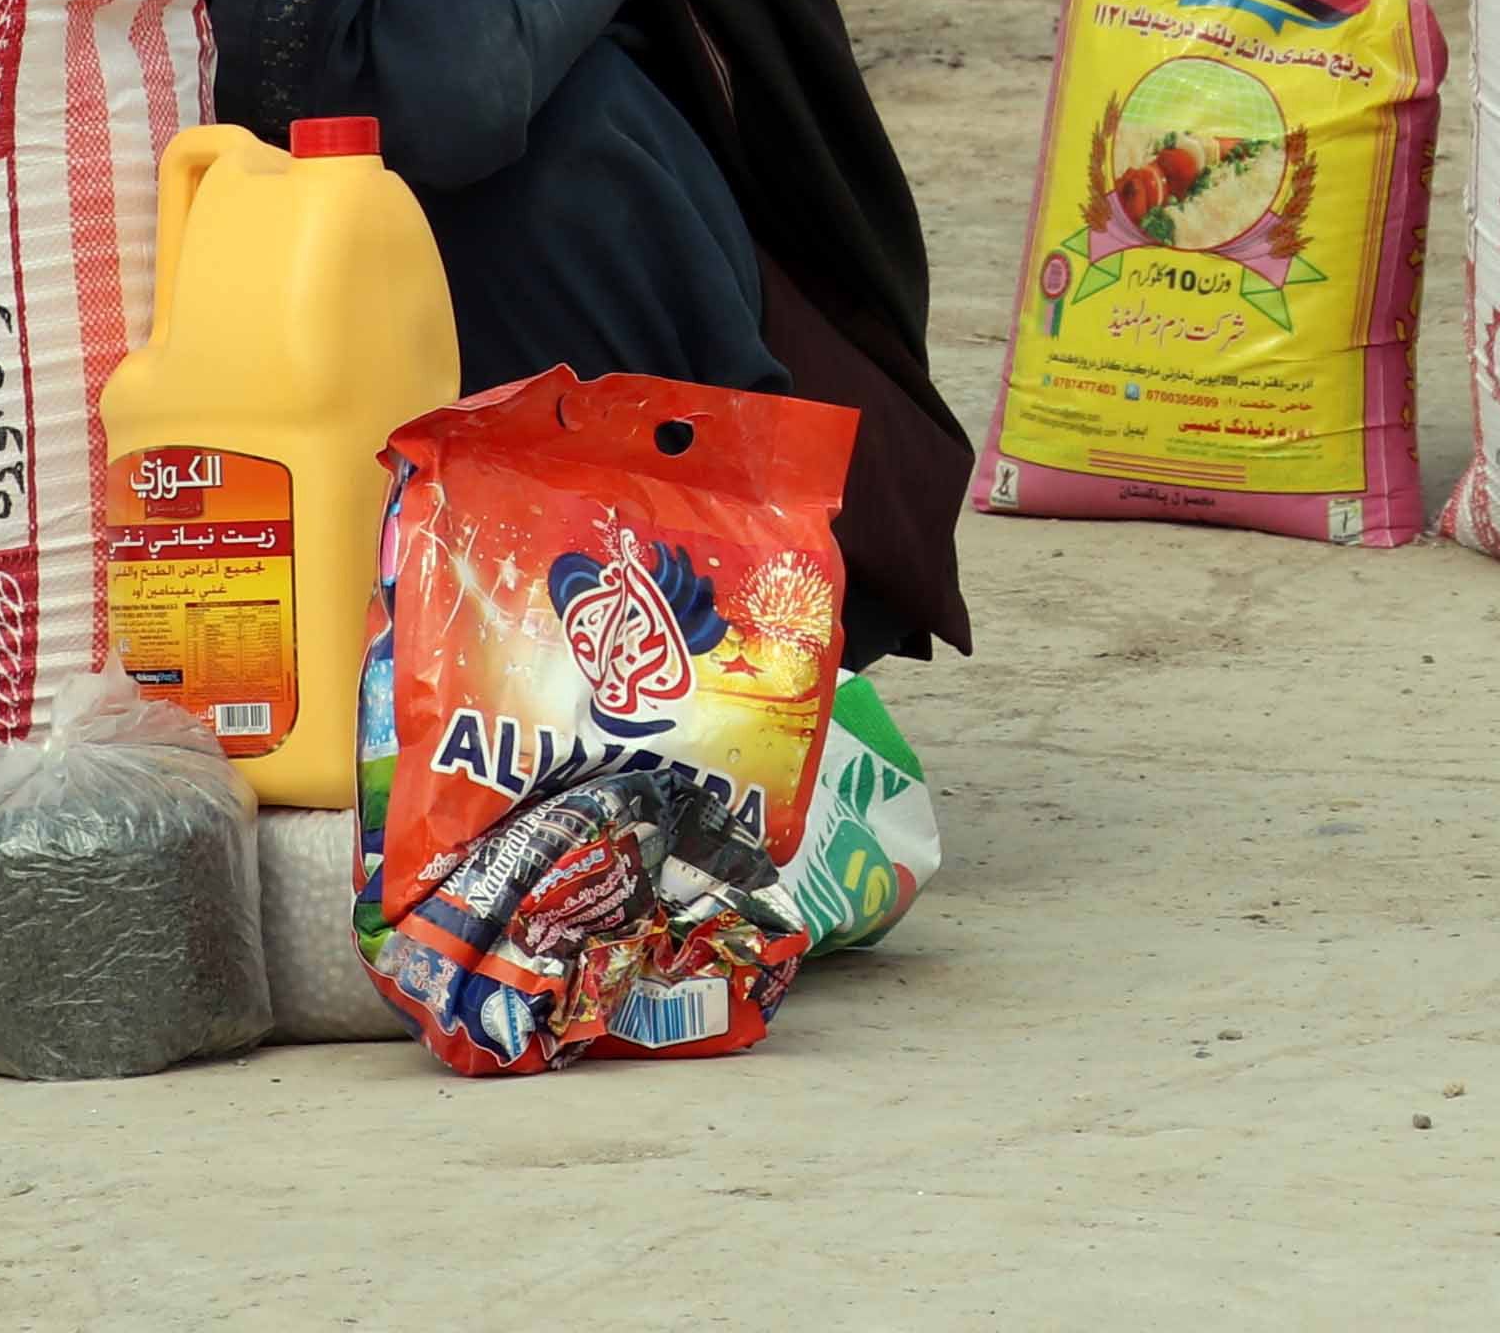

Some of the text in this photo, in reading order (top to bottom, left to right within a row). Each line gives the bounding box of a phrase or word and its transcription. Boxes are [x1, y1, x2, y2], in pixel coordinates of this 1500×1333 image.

[1328, 49, 1374, 87] برنج
[1165, 268, 1197, 293] 10
[1198, 271, 1232, 296] وزن
[130, 454, 223, 500] الكوزي
[148, 524, 277, 560] زيت نباتي
[466, 827, 530, 918] Natural
